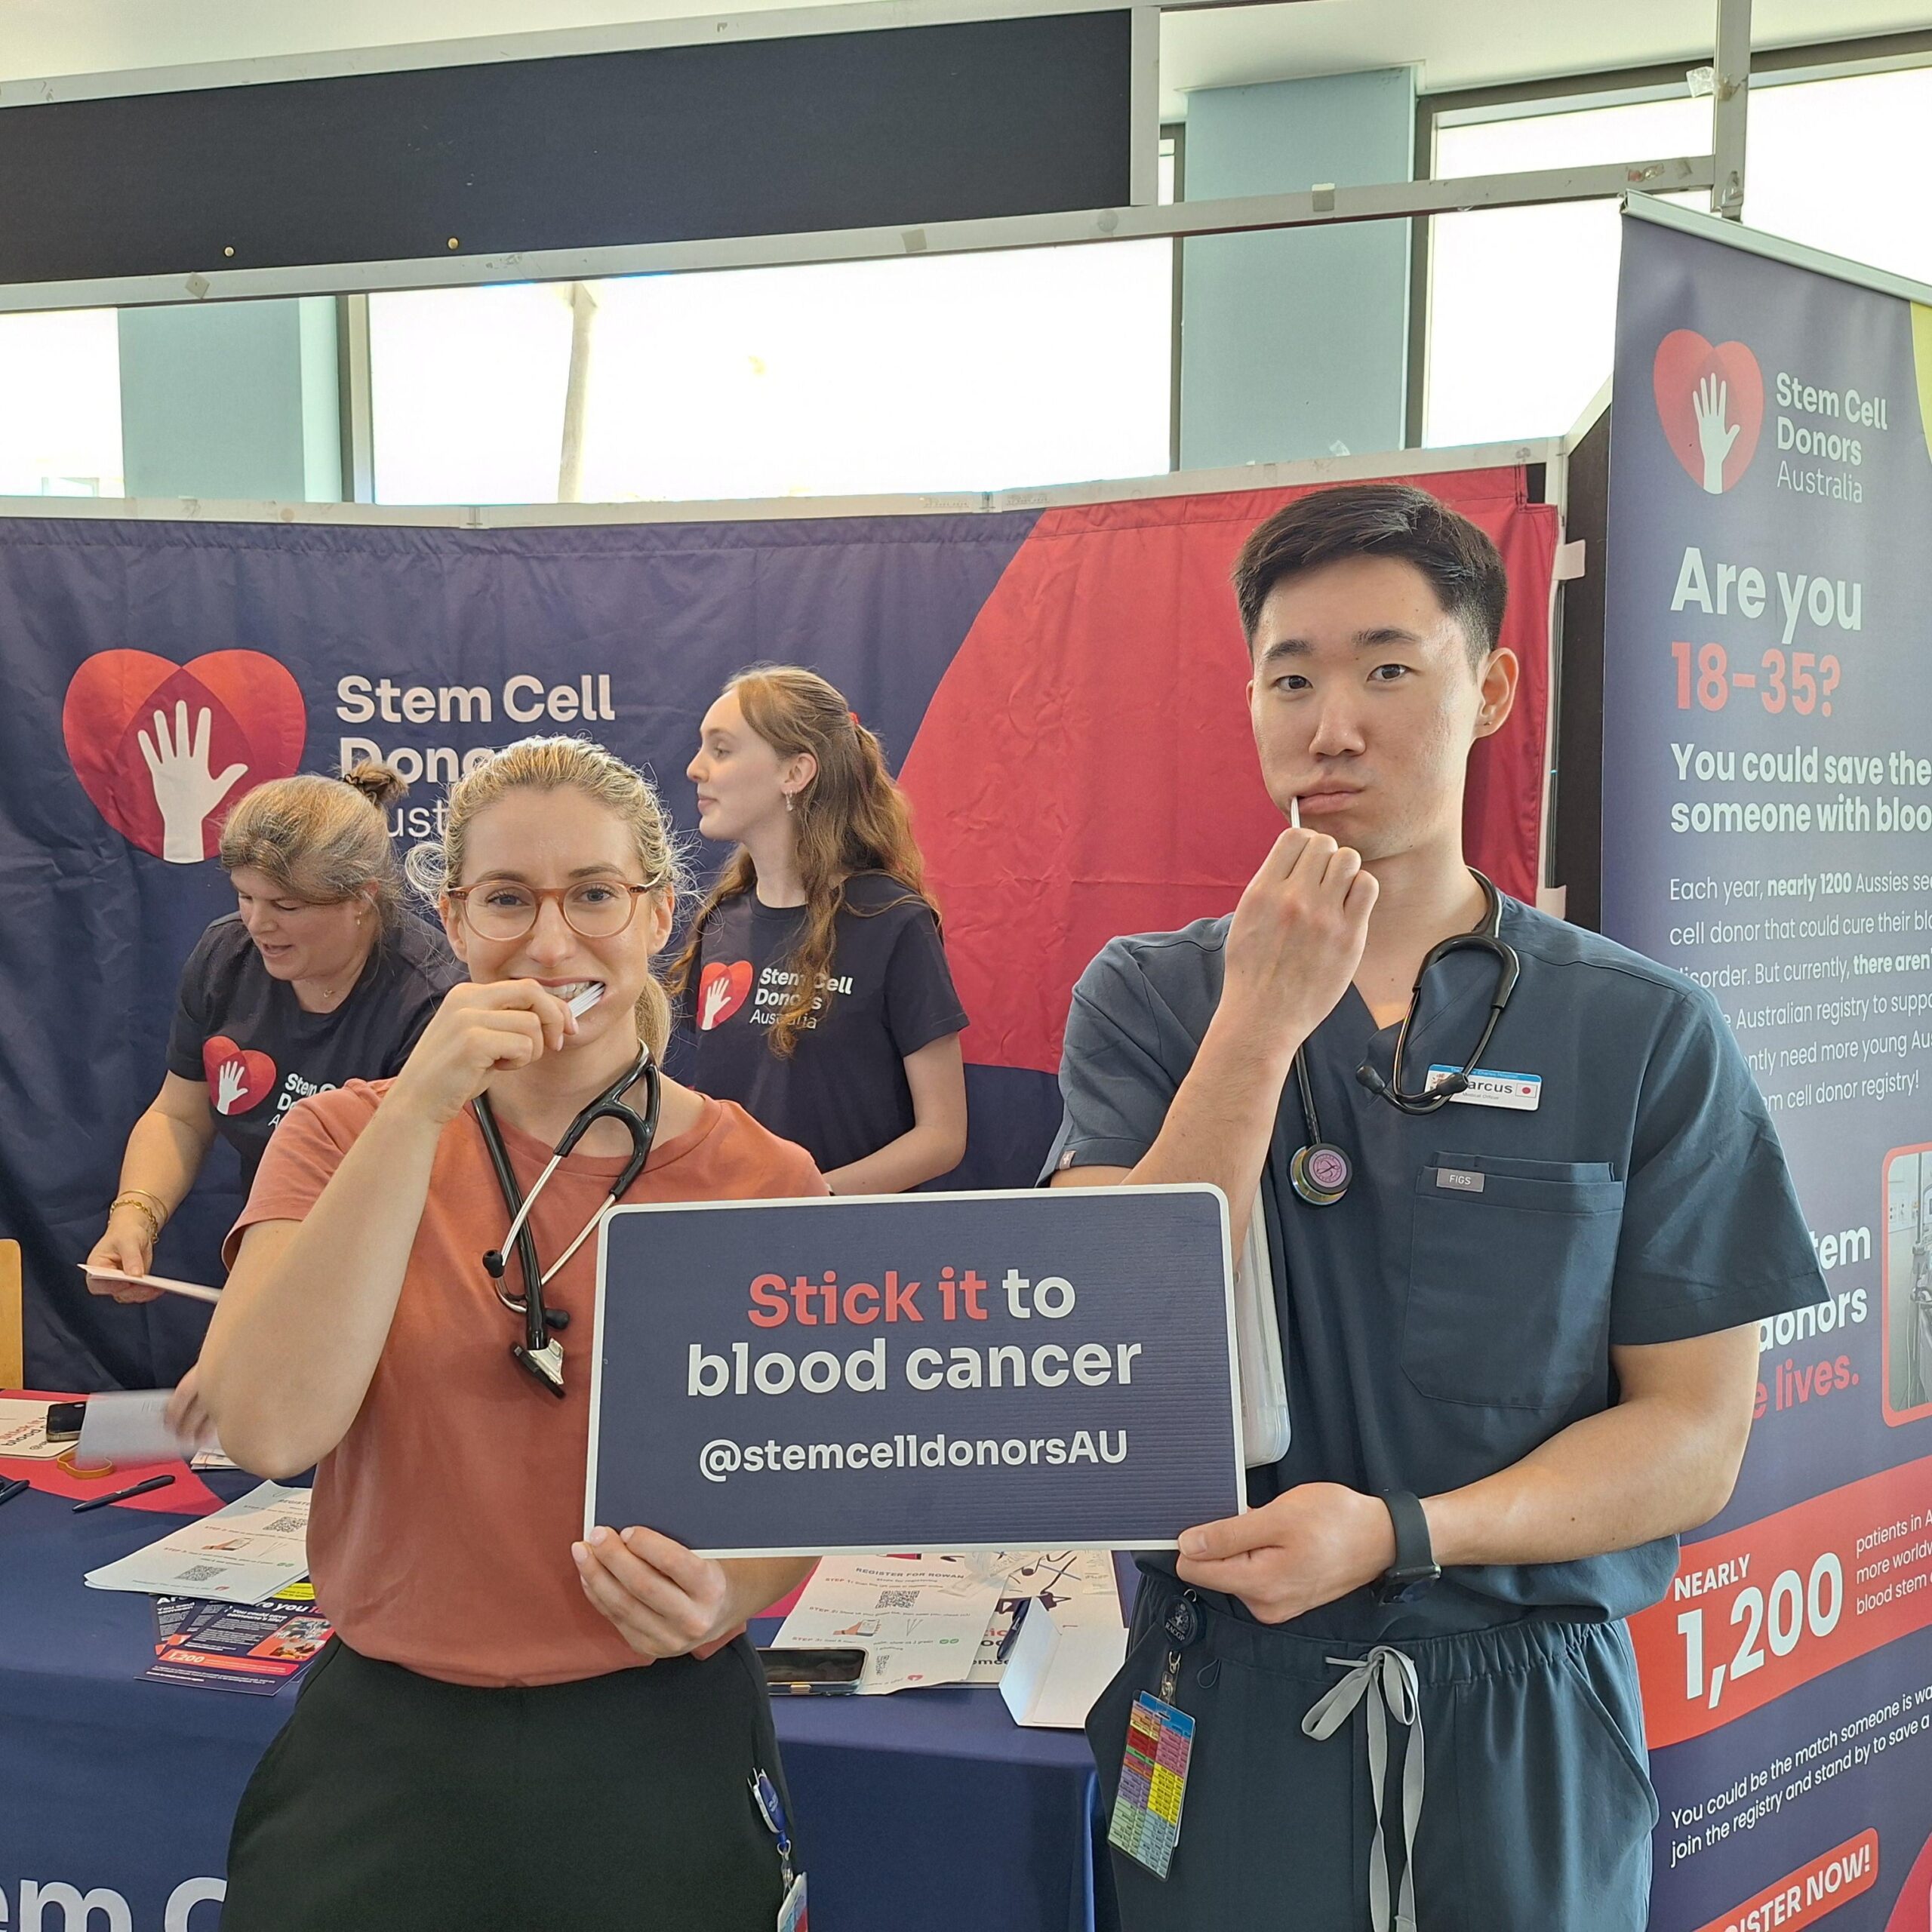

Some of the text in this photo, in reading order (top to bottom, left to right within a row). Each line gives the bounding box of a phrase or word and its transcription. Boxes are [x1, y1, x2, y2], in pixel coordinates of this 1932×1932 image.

[1776, 372, 1887, 430] Stem Cell
[1777, 416, 1862, 466] Donors
[1777, 460, 1863, 503] Australia
[1670, 546, 1862, 645] Are you
[337, 674, 615, 723] Stem Cell
[1670, 743, 1932, 786] You could save the
[1671, 801, 1811, 832] someone
[1817, 793, 1869, 832] with
[1670, 877, 1718, 900] Each
[1723, 881, 1764, 905] year,
[1767, 874, 1817, 902] nearly
[1820, 872, 1852, 894] 1200
[1855, 870, 1909, 893] Aussies
[1669, 921, 1704, 944] cell
[1710, 921, 1760, 943] donor
[1764, 918, 1795, 940] that
[1799, 915, 1838, 937] could
[1843, 918, 1874, 935] cure
[1878, 911, 1910, 934] their
[1755, 962, 1780, 984] But
[1784, 955, 1850, 983] currently,
[1854, 953, 1892, 975] there
[1736, 1001, 1813, 1029] Australian
[1817, 997, 1869, 1025] registry
[1873, 994, 1887, 1014] to
[1744, 1048, 1776, 1075] ntly
[1780, 1041, 1817, 1066] need
[1821, 1041, 1859, 1061] more
[1863, 1034, 1907, 1062] young
[1468, 1081, 1513, 1094] arcus
[1787, 1084, 1812, 1108] cell
[1816, 1081, 1858, 1103] donor
[1862, 1069, 1919, 1100] registry!
[1449, 1174, 1472, 1186] FIGS
[747, 1266, 1075, 1329] Stick it to
[688, 1338, 1143, 1397] blood cancer
[1776, 1355, 1860, 1411] lives.
[700, 1429, 1128, 1483] @stemcelldonorsAU
[1857, 1521, 1907, 1559] patients
[1911, 1514, 1921, 1532] in
[1675, 1553, 1750, 1601] NEARLY
[1857, 1559, 1890, 1584] more
[272, 1603, 310, 1613] you
[1857, 1574, 1927, 1615] blood stem
[1678, 1552, 1842, 1709] 1,200
[168, 1652, 206, 1663] 1,200
[1670, 1802, 1703, 1829] You
[1706, 1776, 1747, 1814] could
[1750, 1769, 1767, 1792] be
[1770, 1755, 1792, 1781] the
[1795, 1730, 1838, 1767] match
[1841, 1702, 1899, 1742] someone
[1902, 1693, 1912, 1712] is
[1670, 1714, 1930, 1869] join the registry and stand by to save a
[1806, 1844, 1870, 1906] NOW!
